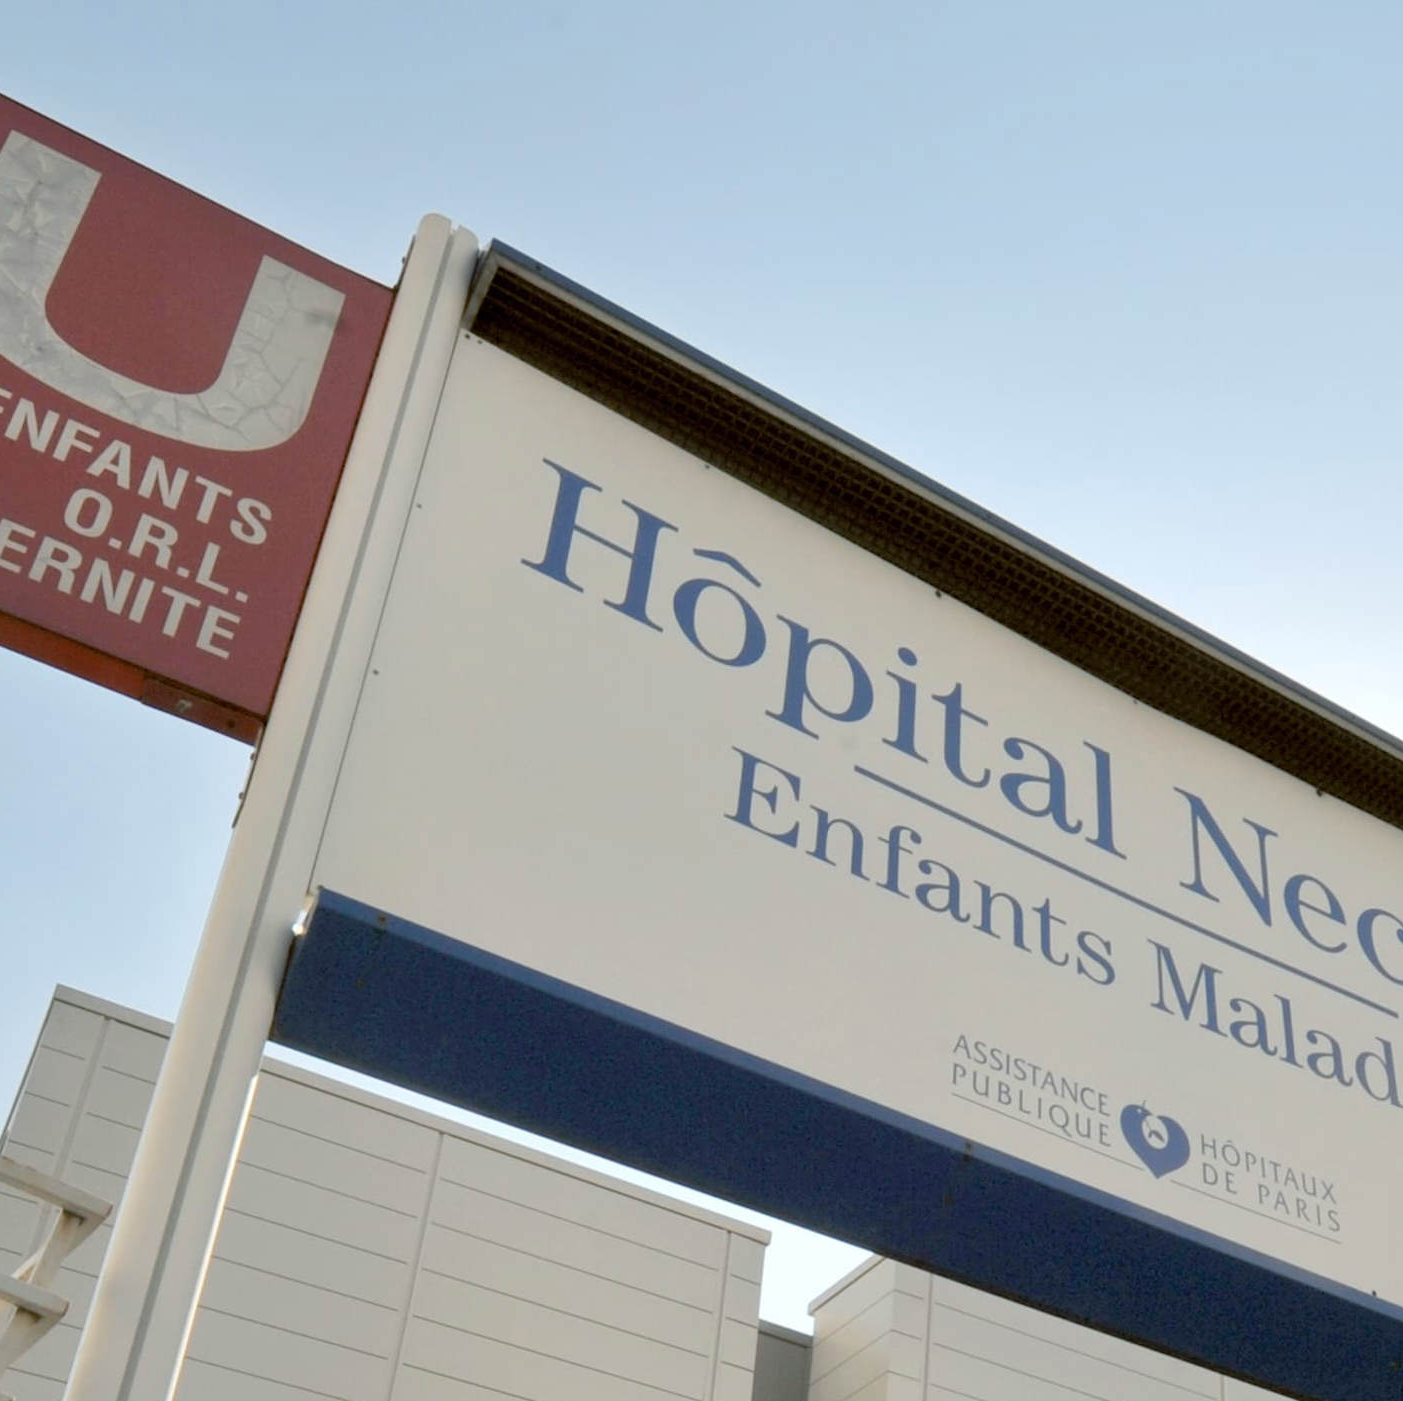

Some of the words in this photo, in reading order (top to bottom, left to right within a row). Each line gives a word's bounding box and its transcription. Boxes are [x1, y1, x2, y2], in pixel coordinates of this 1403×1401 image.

[63, 487, 249, 603] O.R.L.
[521, 458, 1128, 860] Hôpital
[723, 747, 1117, 988] Enfants
[952, 1033, 1111, 1117] ASSISTANCE
[952, 1062, 1112, 1147] PUBLIQUE
[1200, 1133, 1338, 1205] HÔPITAUX
[1202, 1162, 1238, 1195] DE
[1257, 1184, 1341, 1232] PARIS
